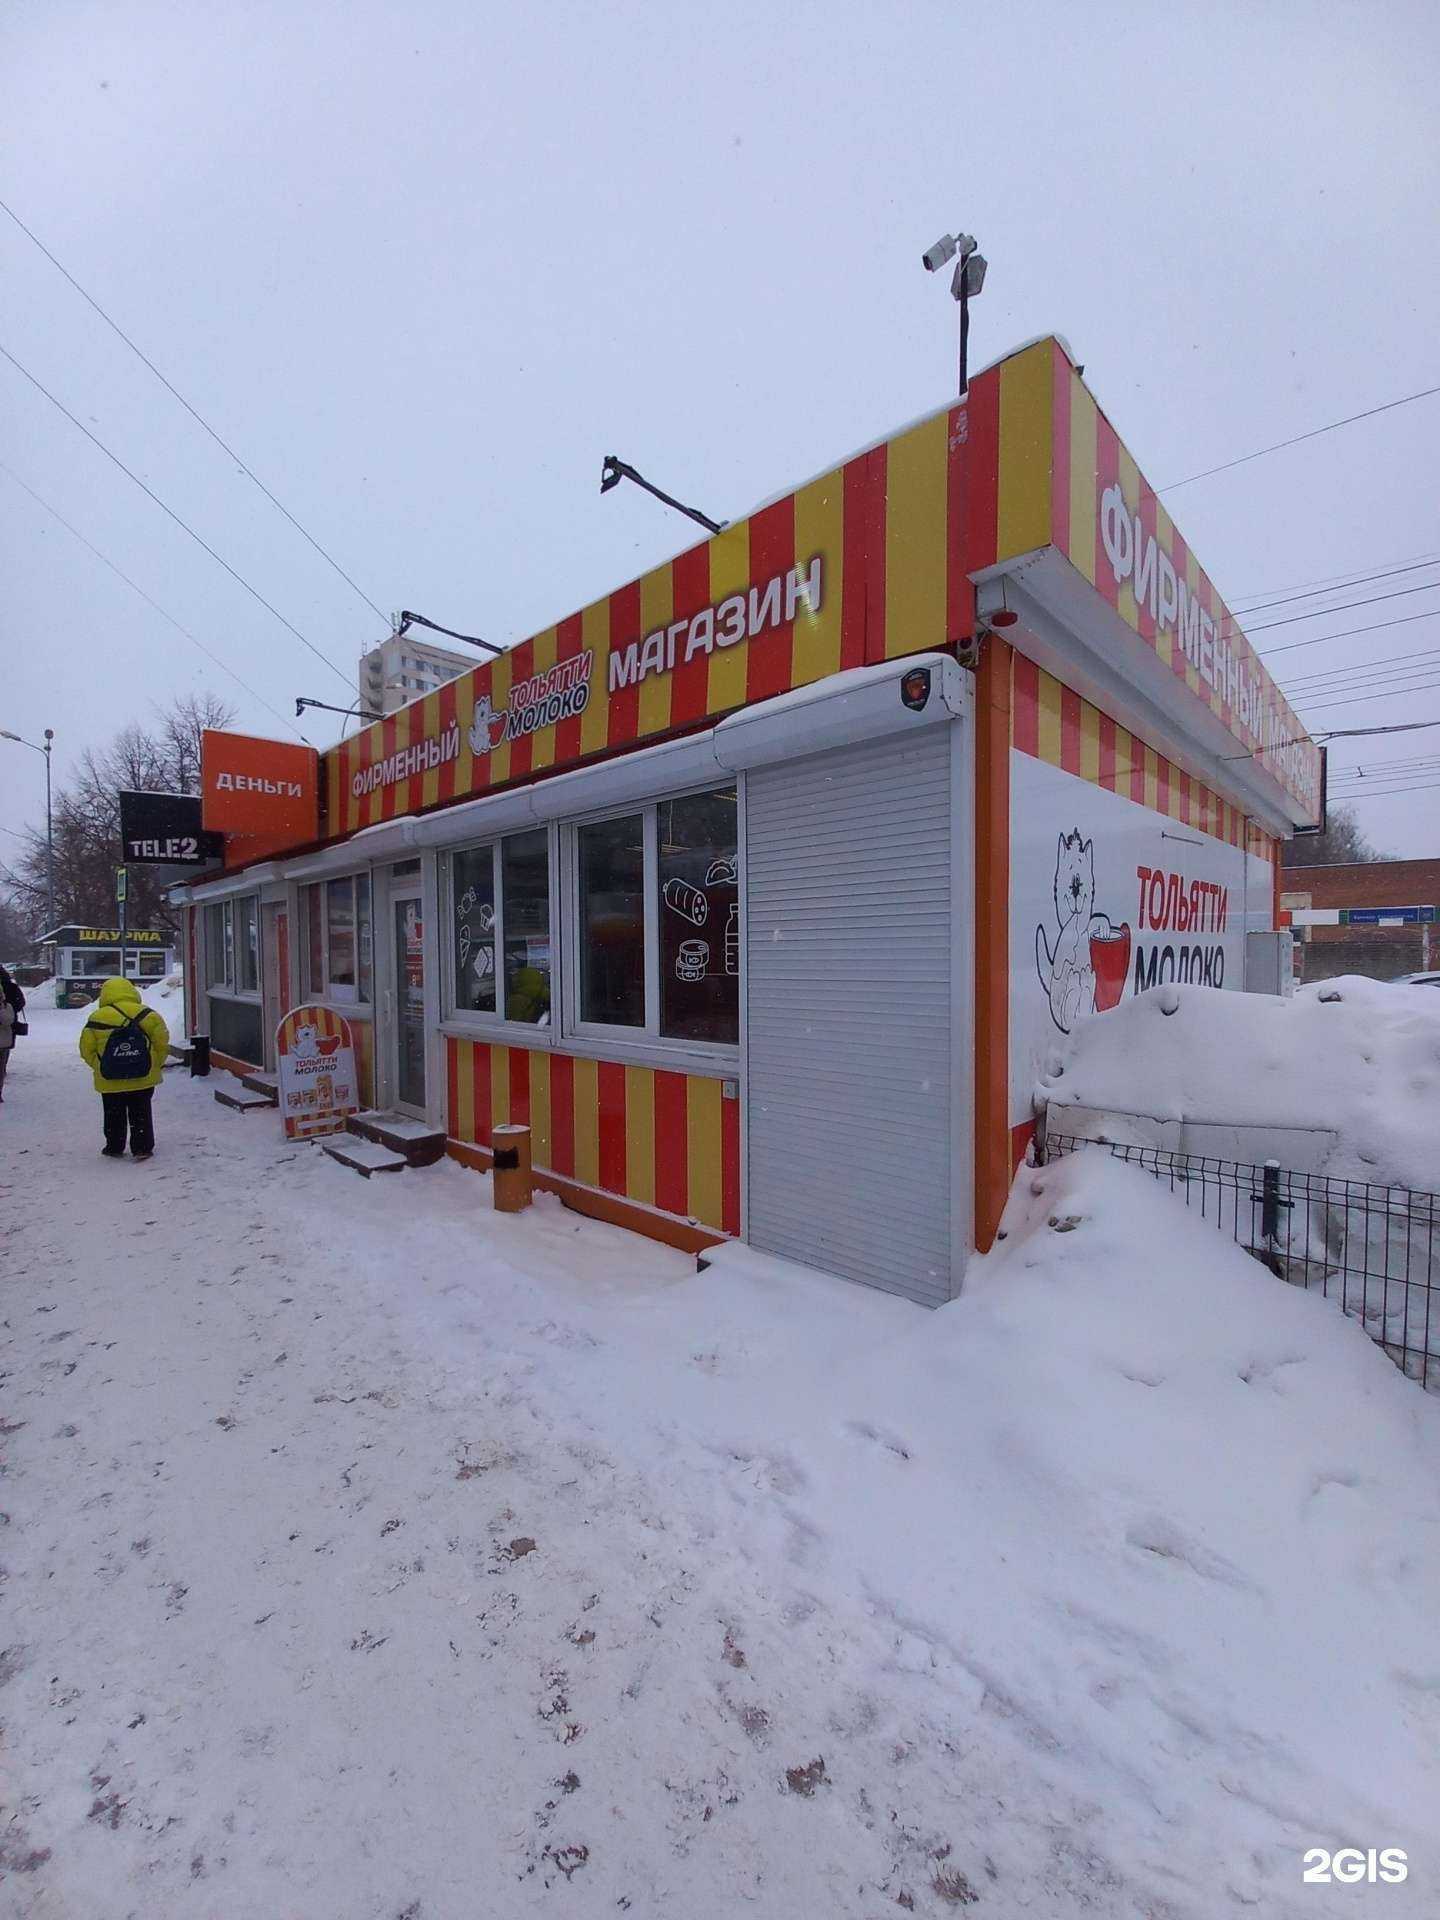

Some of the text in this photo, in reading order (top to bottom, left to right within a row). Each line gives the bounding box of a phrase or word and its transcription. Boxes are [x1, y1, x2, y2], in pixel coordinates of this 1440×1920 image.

[1101, 483, 1264, 744] ФИРМЕННЫЙ
[353, 557, 821, 797] ФИРМЕННЫЙ МАГАЗИН
[508, 650, 593, 713] ТОЛЬЯТТИ
[507, 683, 589, 740] МОЛОКО
[216, 772, 302, 797] ДЕНЬГИ
[129, 837, 200, 860] TELE2
[1137, 866, 1228, 933] ТОЛЬЯТТИ
[1134, 945, 1225, 995] МОЛОКО
[295, 1064, 338, 1075] МОЛОКО
[296, 1056, 338, 1067] ТОЛЬЯТТИ
